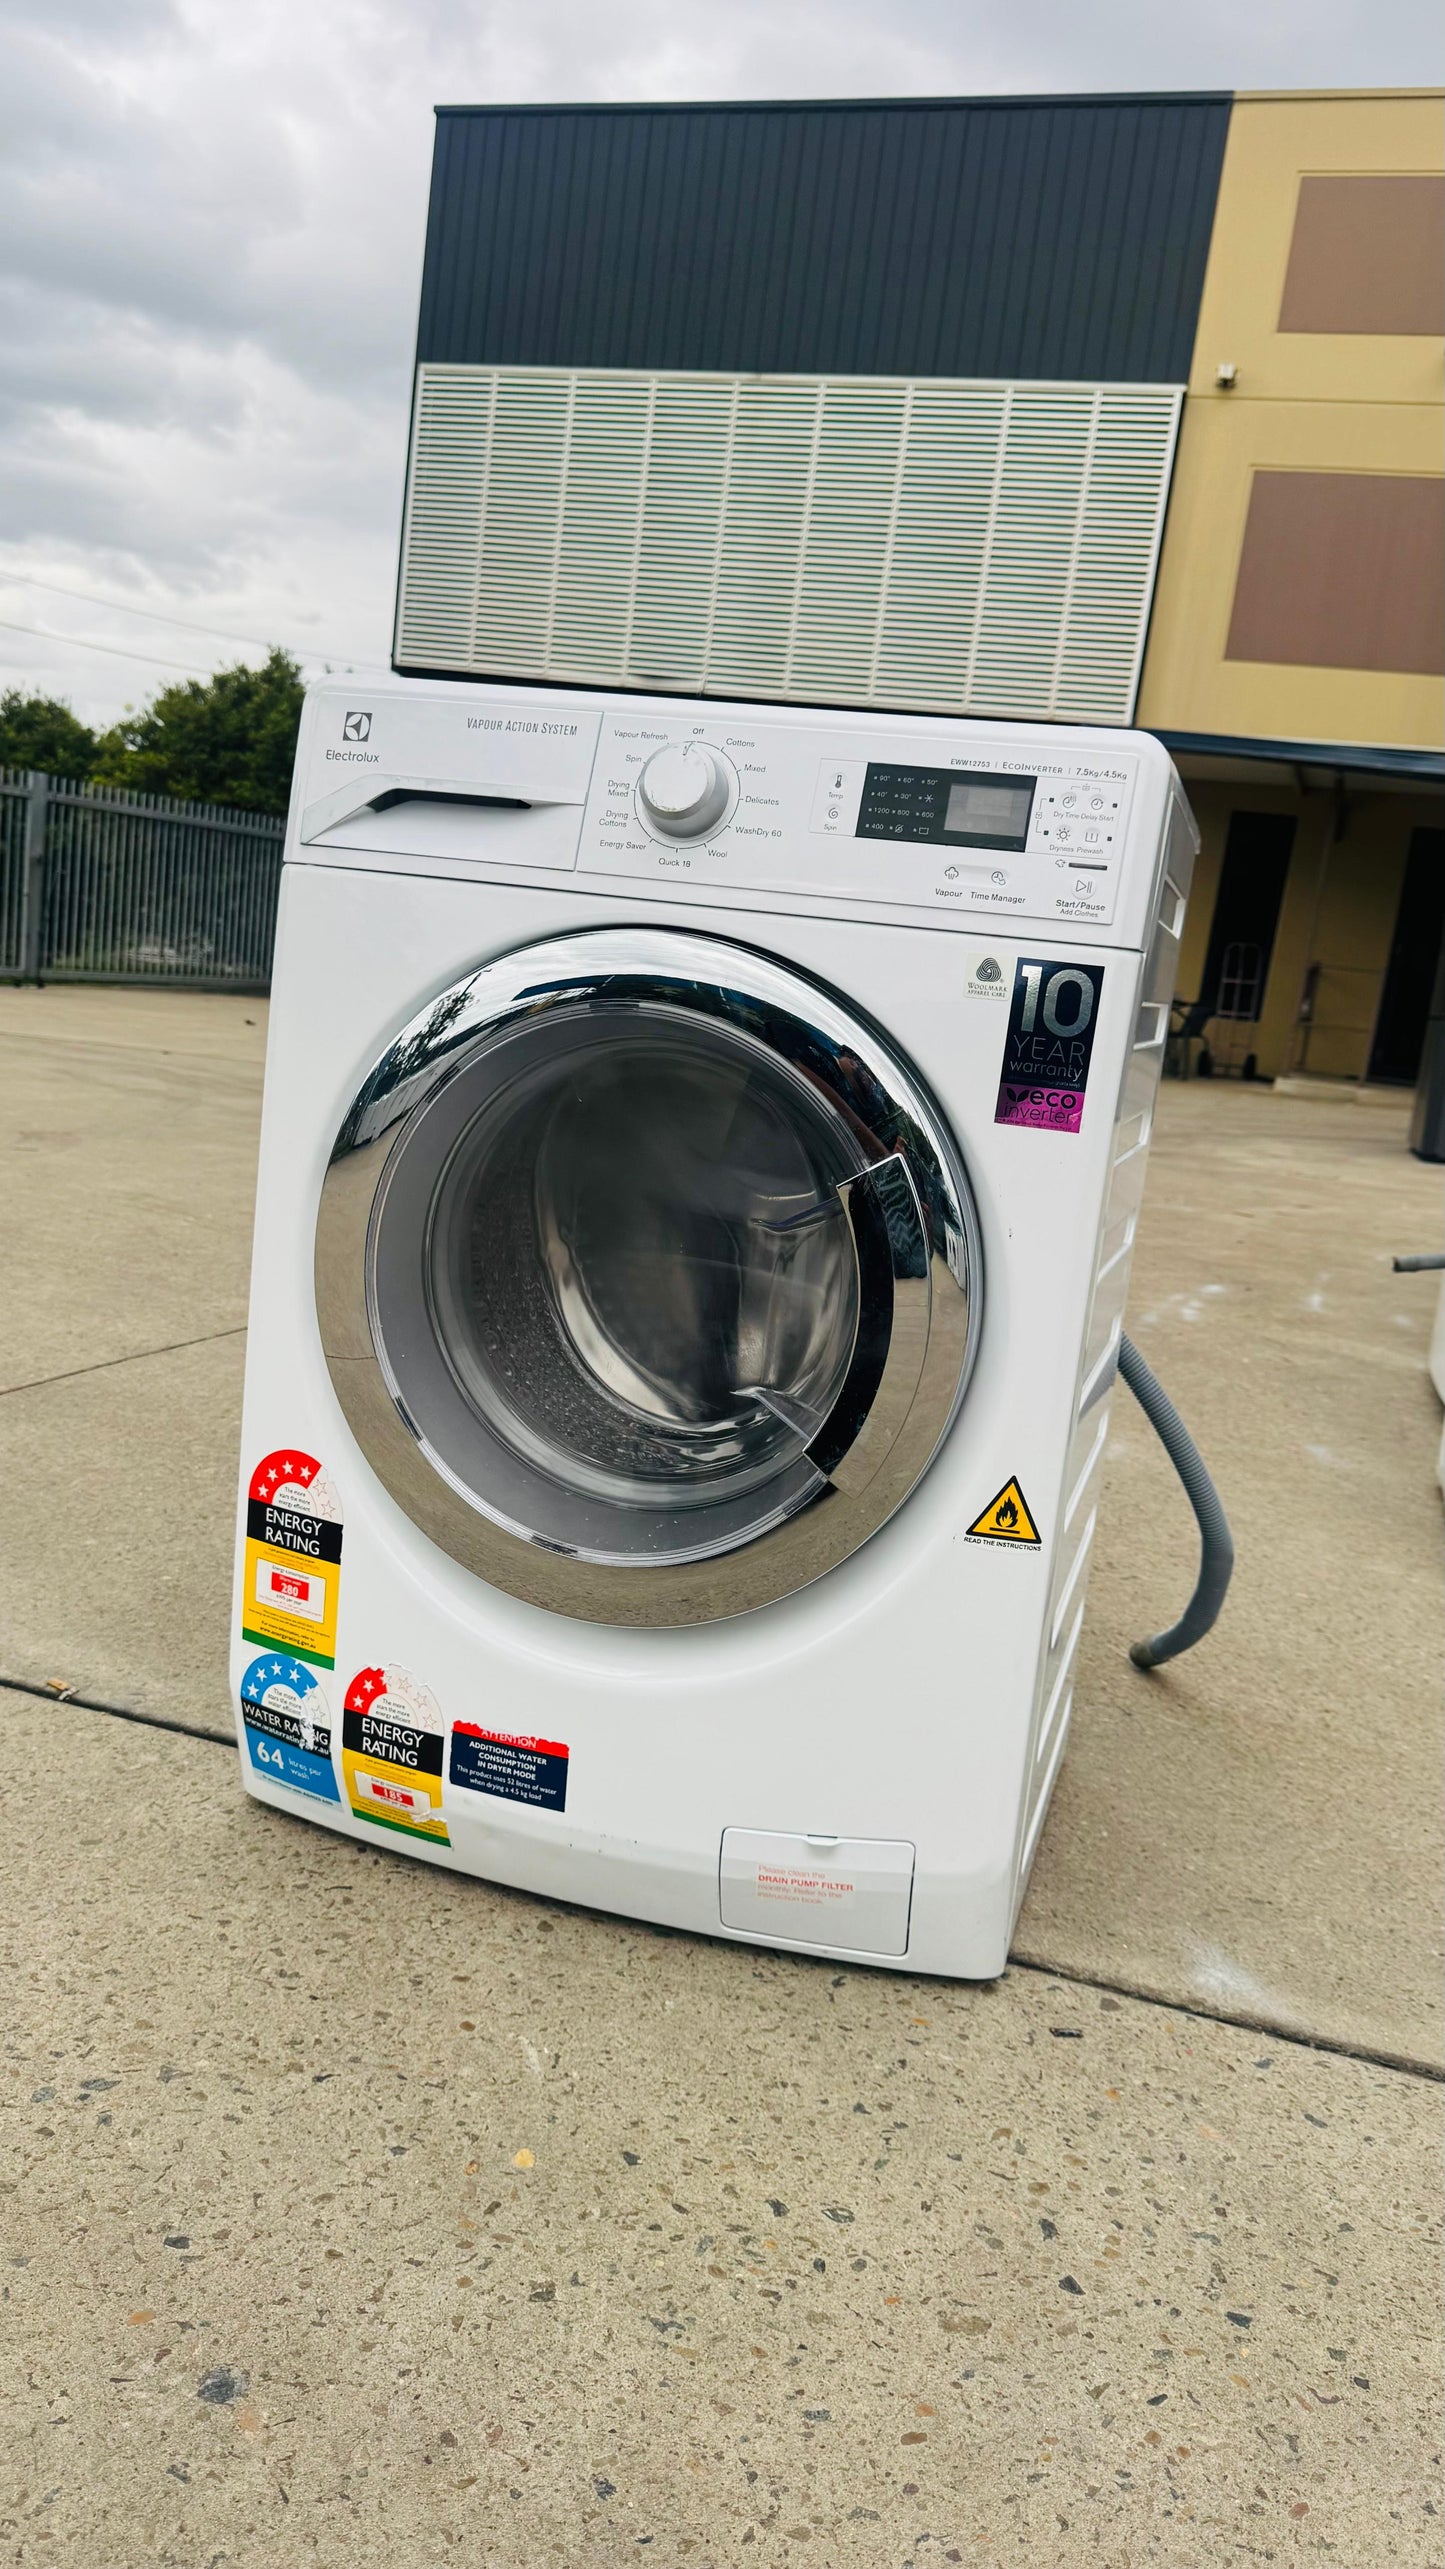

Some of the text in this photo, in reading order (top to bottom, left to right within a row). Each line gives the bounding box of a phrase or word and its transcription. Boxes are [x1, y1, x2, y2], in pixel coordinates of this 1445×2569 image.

[467, 717, 578, 736] VAPOUR ACTION SYSTEM
[614, 730, 668, 741] Vapour Refresh
[726, 738, 755, 748] Cottons
[326, 749, 380, 763] Electrolux
[625, 754, 642, 763] Spin
[744, 764, 766, 773] Mixed
[950, 758, 990, 769] EWW12753
[607, 780, 630, 790] Drying
[607, 789, 629, 798] Mixed
[828, 792, 844, 800] Temp
[745, 796, 780, 806] Delicates
[605, 810, 629, 820] Drying
[1053, 810, 1080, 819] Dry Time
[1081, 813, 1098, 822] Delay
[599, 818, 627, 828] Cottons
[824, 823, 837, 832] Spin
[735, 826, 782, 838] WashDry 60
[599, 839, 647, 850] Energy Saver
[1049, 844, 1074, 853] Dryness
[1076, 846, 1104, 855] Prewash
[707, 850, 728, 858] Wool
[658, 858, 691, 868] Quick 18
[935, 888, 962, 899] Vapour
[970, 891, 1026, 904] Time Manager
[1055, 899, 1106, 912] Start/Pause
[1074, 909, 1098, 918] Clothes
[967, 982, 1008, 992] WOOLMARK
[967, 989, 990, 997] APPAREL
[1021, 964, 1095, 1038] 10
[1013, 1034, 1086, 1066] YEAR
[1009, 1059, 1083, 1082] warranty
[1029, 1089, 1077, 1110] eco
[1004, 1102, 1073, 1125] inverter
[265, 1507, 322, 1536] ENERGY
[265, 1526, 320, 1555] RATING
[963, 1536, 1042, 1551] READ THE INSTRUCTIONS
[281, 1583, 299, 1597] 280
[397, 1710, 410, 1718] more
[243, 1702, 328, 1745] WATER RANG
[362, 1717, 424, 1748] ENERGY
[481, 1730, 537, 1748] ATTENTION
[362, 1736, 418, 1766] RATING
[469, 1740, 547, 1766] ADDITIONAL WATER
[257, 1741, 285, 1770] 64
[309, 1767, 322, 1777] per
[478, 1752, 536, 1772] CONSUMPTION
[290, 1768, 310, 1780] wash
[477, 1760, 536, 1780] IN DRYER MODE
[457, 1764, 557, 1795] This product uses 52 litres of water
[383, 1788, 403, 1802] 185
[469, 1777, 486, 1787] when
[486, 1780, 504, 1793] drying
[510, 1786, 519, 1795] 4.5
[520, 1788, 528, 1798] kg
[528, 1791, 542, 1801] load
[758, 1865, 826, 1879] Please clean the
[758, 1874, 854, 1892] DRAIN PUMP FILTER
[757, 1892, 800, 1902] instruction
[794, 1887, 816, 1896] Refer
